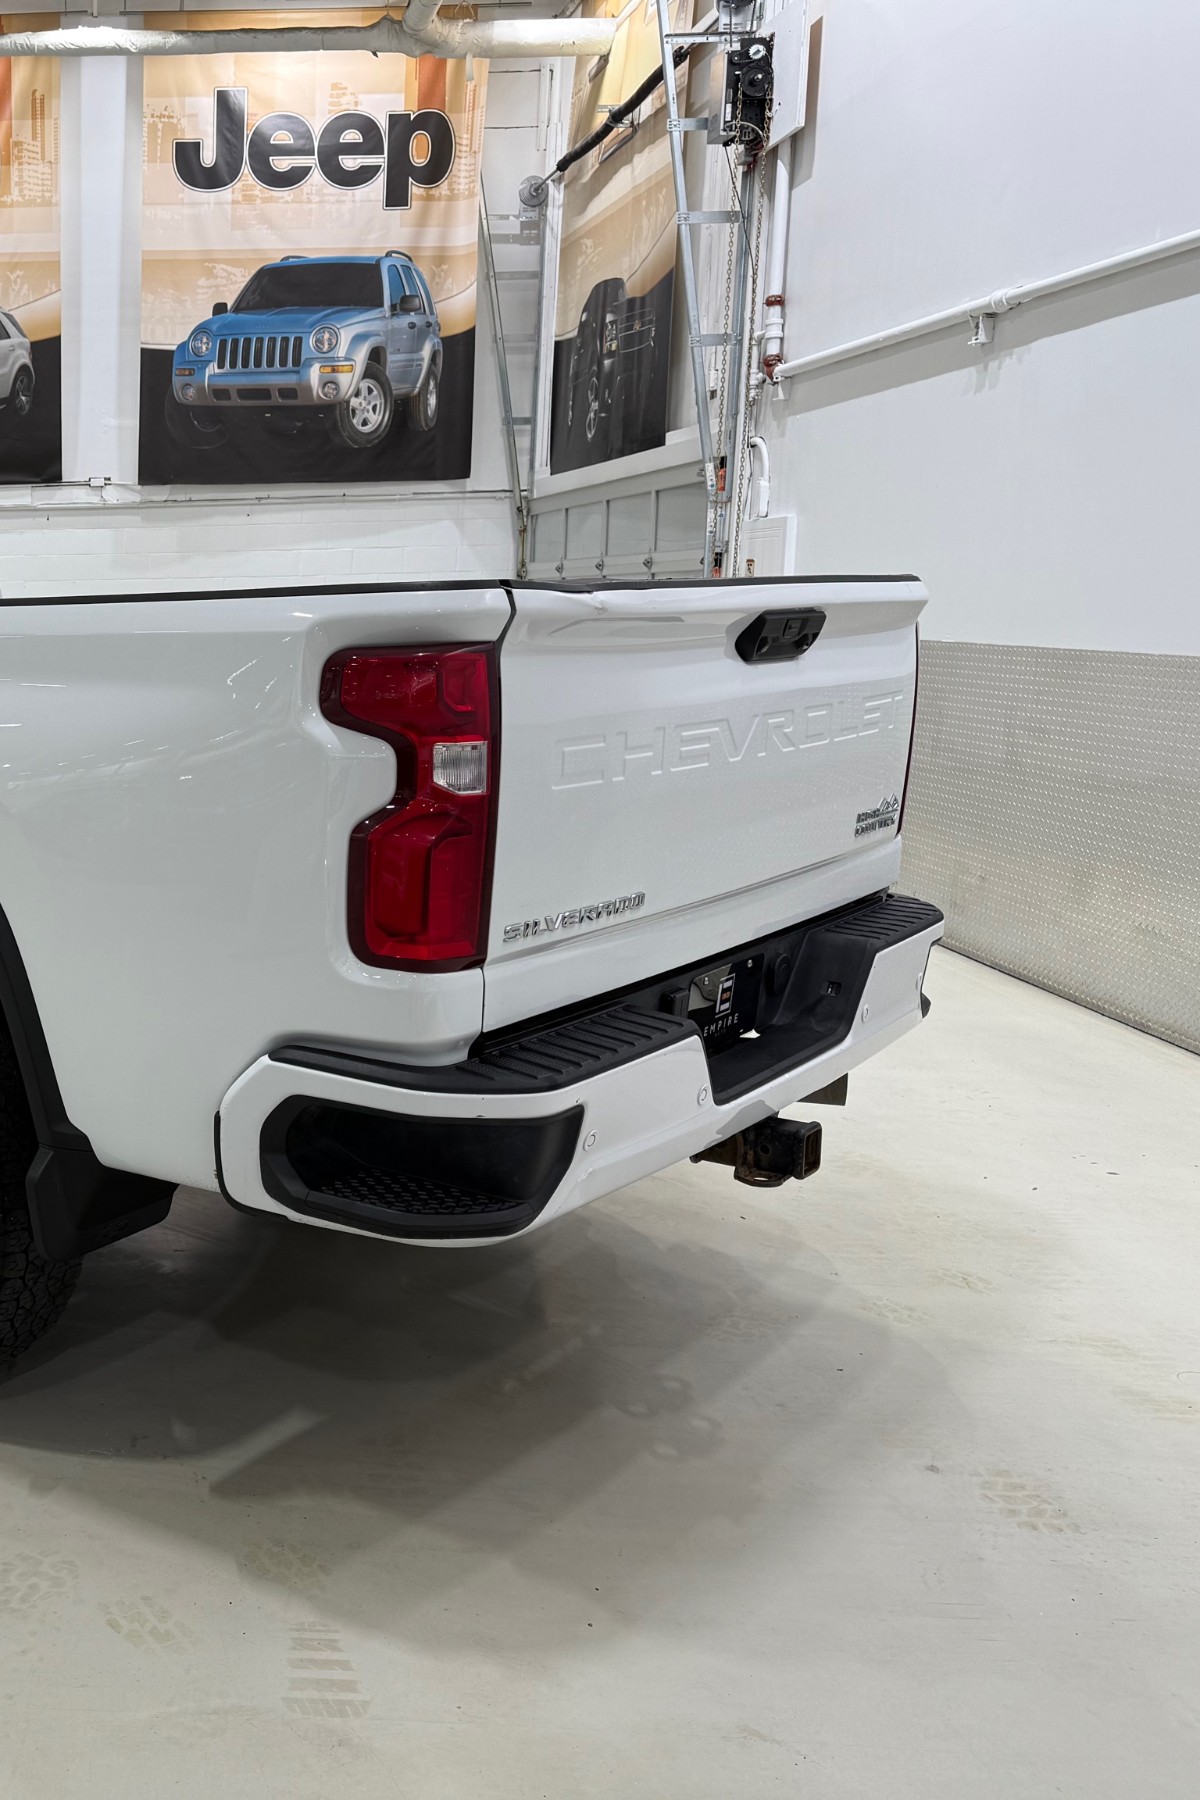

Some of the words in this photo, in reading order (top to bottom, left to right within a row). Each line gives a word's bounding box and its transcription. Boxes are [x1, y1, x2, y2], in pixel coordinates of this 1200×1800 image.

[172, 86, 456, 210] Jeep
[552, 690, 904, 789] CHEVROLET
[503, 891, 646, 943] SILVERADO
[703, 1013, 739, 1037] EMPIRE
